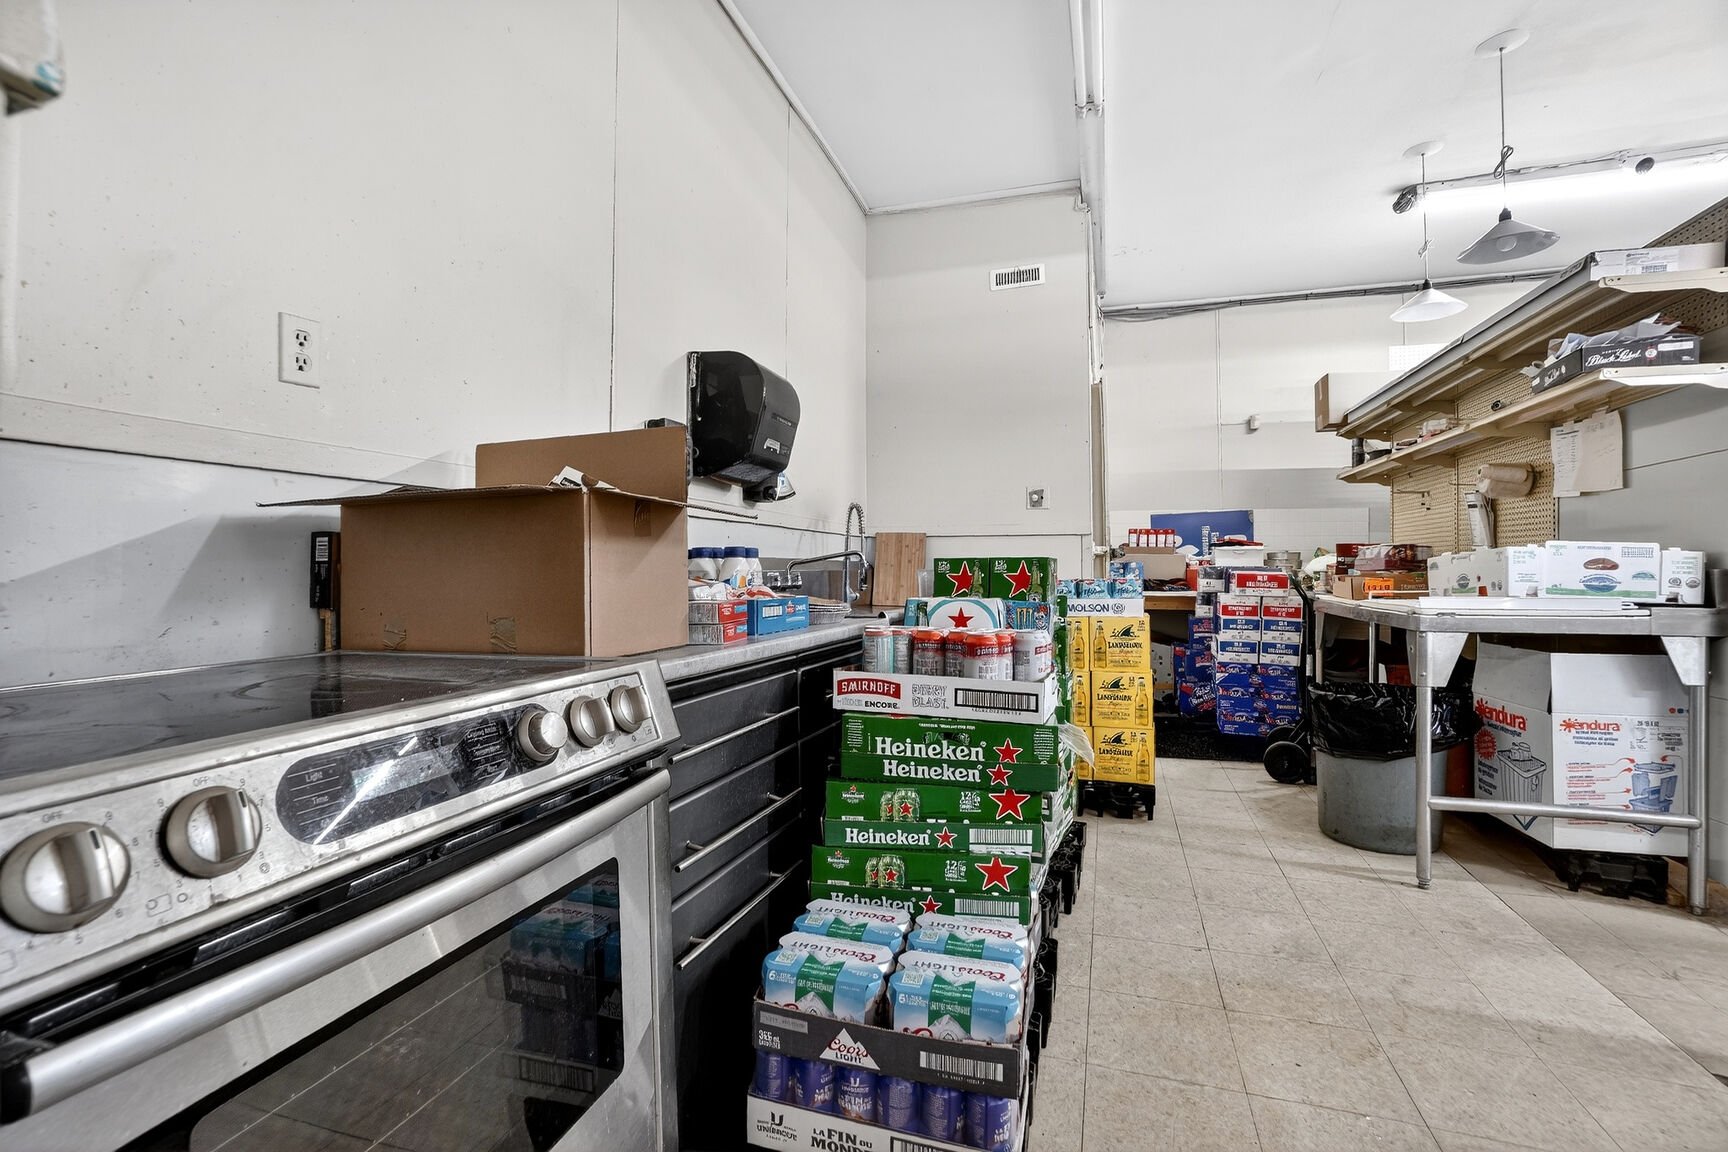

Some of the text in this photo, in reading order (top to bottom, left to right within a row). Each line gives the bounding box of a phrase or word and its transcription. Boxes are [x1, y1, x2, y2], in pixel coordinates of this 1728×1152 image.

[1585, 354, 1616, 367] Black
[1067, 603, 1110, 613] MOLSON
[841, 680, 896, 695] SMIRNOFF
[864, 700, 899, 710] ENCORE
[1482, 704, 1527, 731] endura
[1574, 719, 1621, 732] endura
[875, 736, 985, 762] Heineken
[883, 759, 982, 783] Heineken
[193, 776, 209, 787] OFF
[41, 810, 63, 823] OFF
[845, 827, 931, 846] Heineken
[818, 905, 855, 917] LIGHT
[928, 920, 1013, 940] Coors LIGHT
[791, 940, 877, 963] Coors LIGHT
[913, 960, 1006, 982] Coors LIGHT
[827, 1038, 869, 1058] Coors
[835, 1052, 862, 1064] LIGHT
[812, 1127, 873, 1149] LA FIN DU
